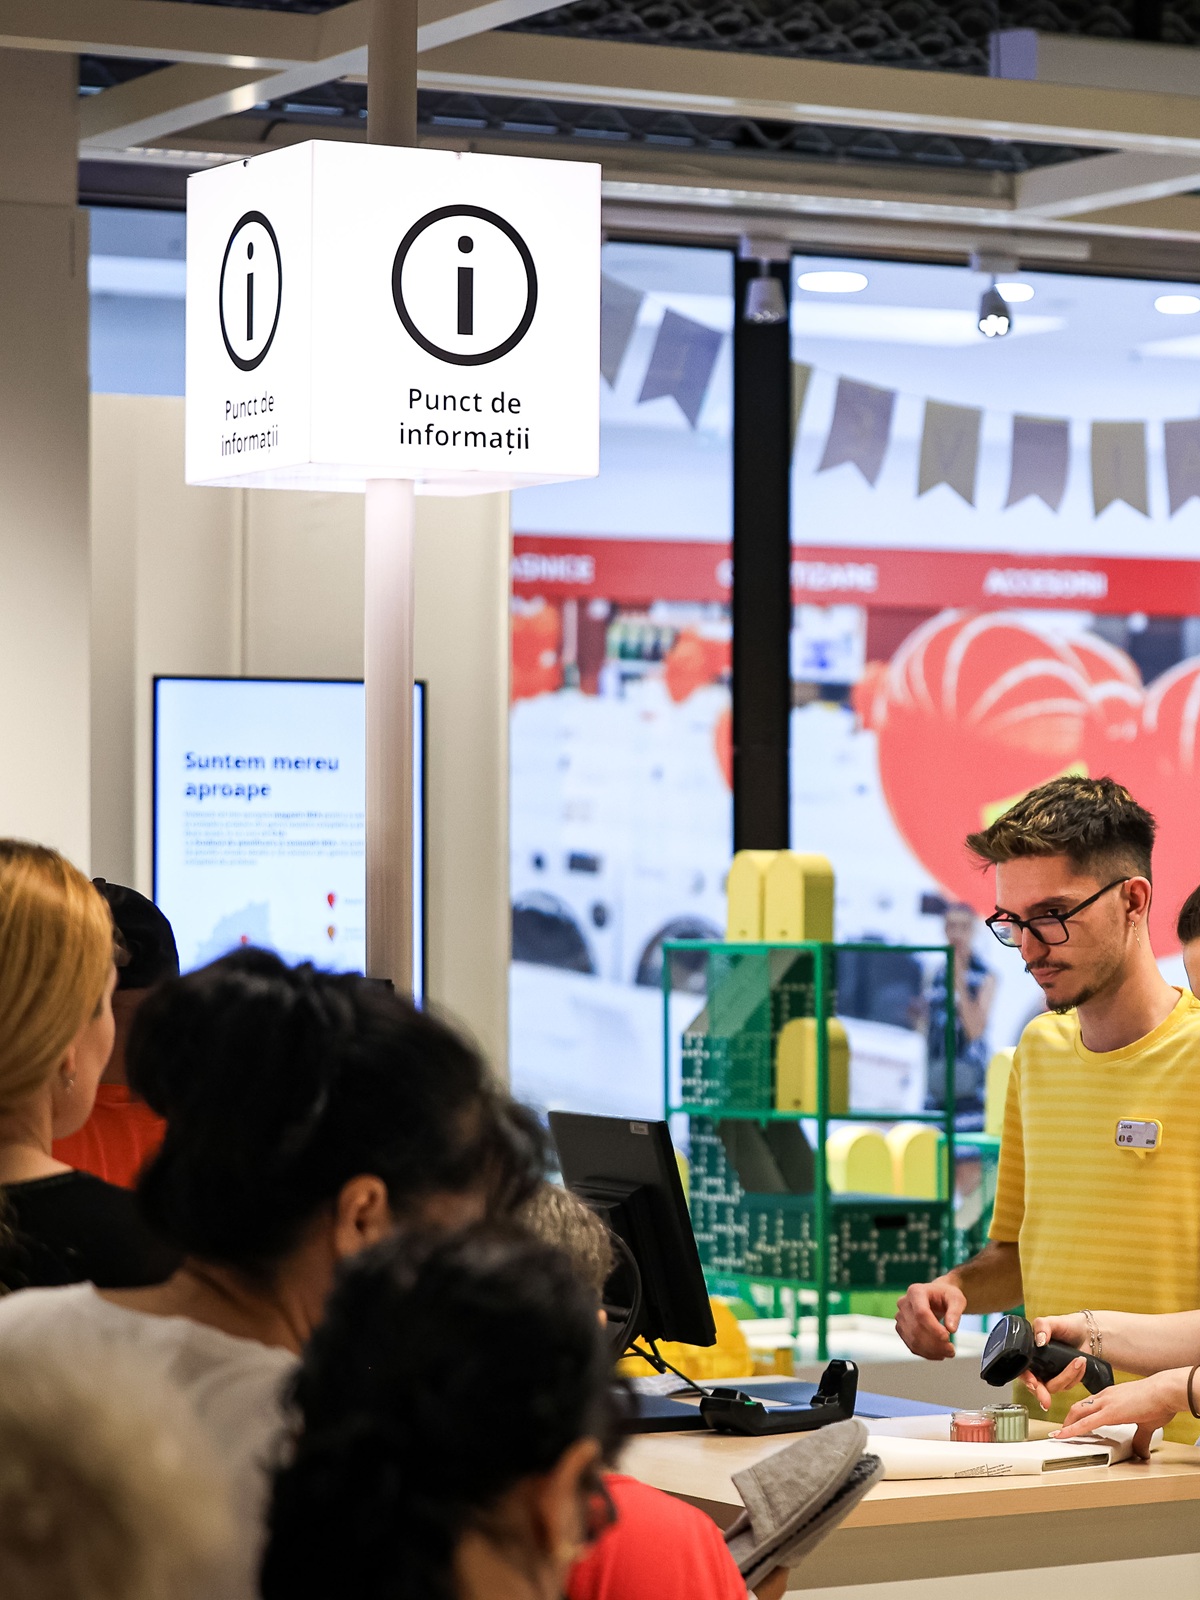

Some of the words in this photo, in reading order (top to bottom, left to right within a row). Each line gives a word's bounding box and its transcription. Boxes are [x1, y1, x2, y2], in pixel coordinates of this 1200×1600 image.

[225, 397, 258, 422] Punct
[260, 389, 275, 414] de
[408, 387, 483, 414] Punct
[490, 390, 523, 416] de
[398, 421, 531, 456] informații
[183, 749, 267, 771] Suntem
[271, 755, 340, 773] mereu
[183, 781, 272, 803] aproape
